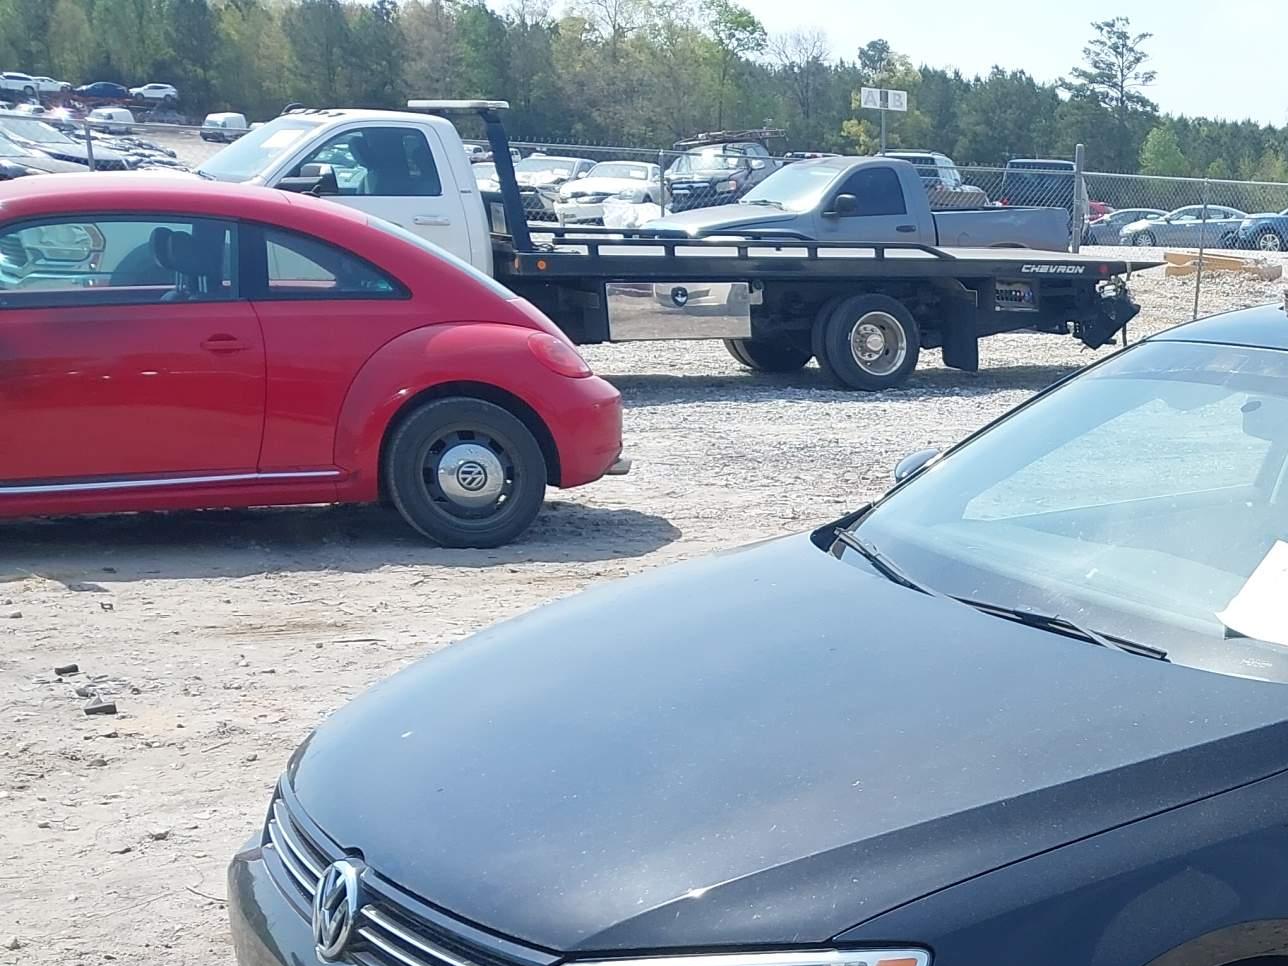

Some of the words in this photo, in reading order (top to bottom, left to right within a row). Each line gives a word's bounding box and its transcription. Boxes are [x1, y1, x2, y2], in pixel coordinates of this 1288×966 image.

[863, 90, 878, 107] A
[892, 92, 904, 109] B
[1021, 264, 1086, 274] CHEVRON
